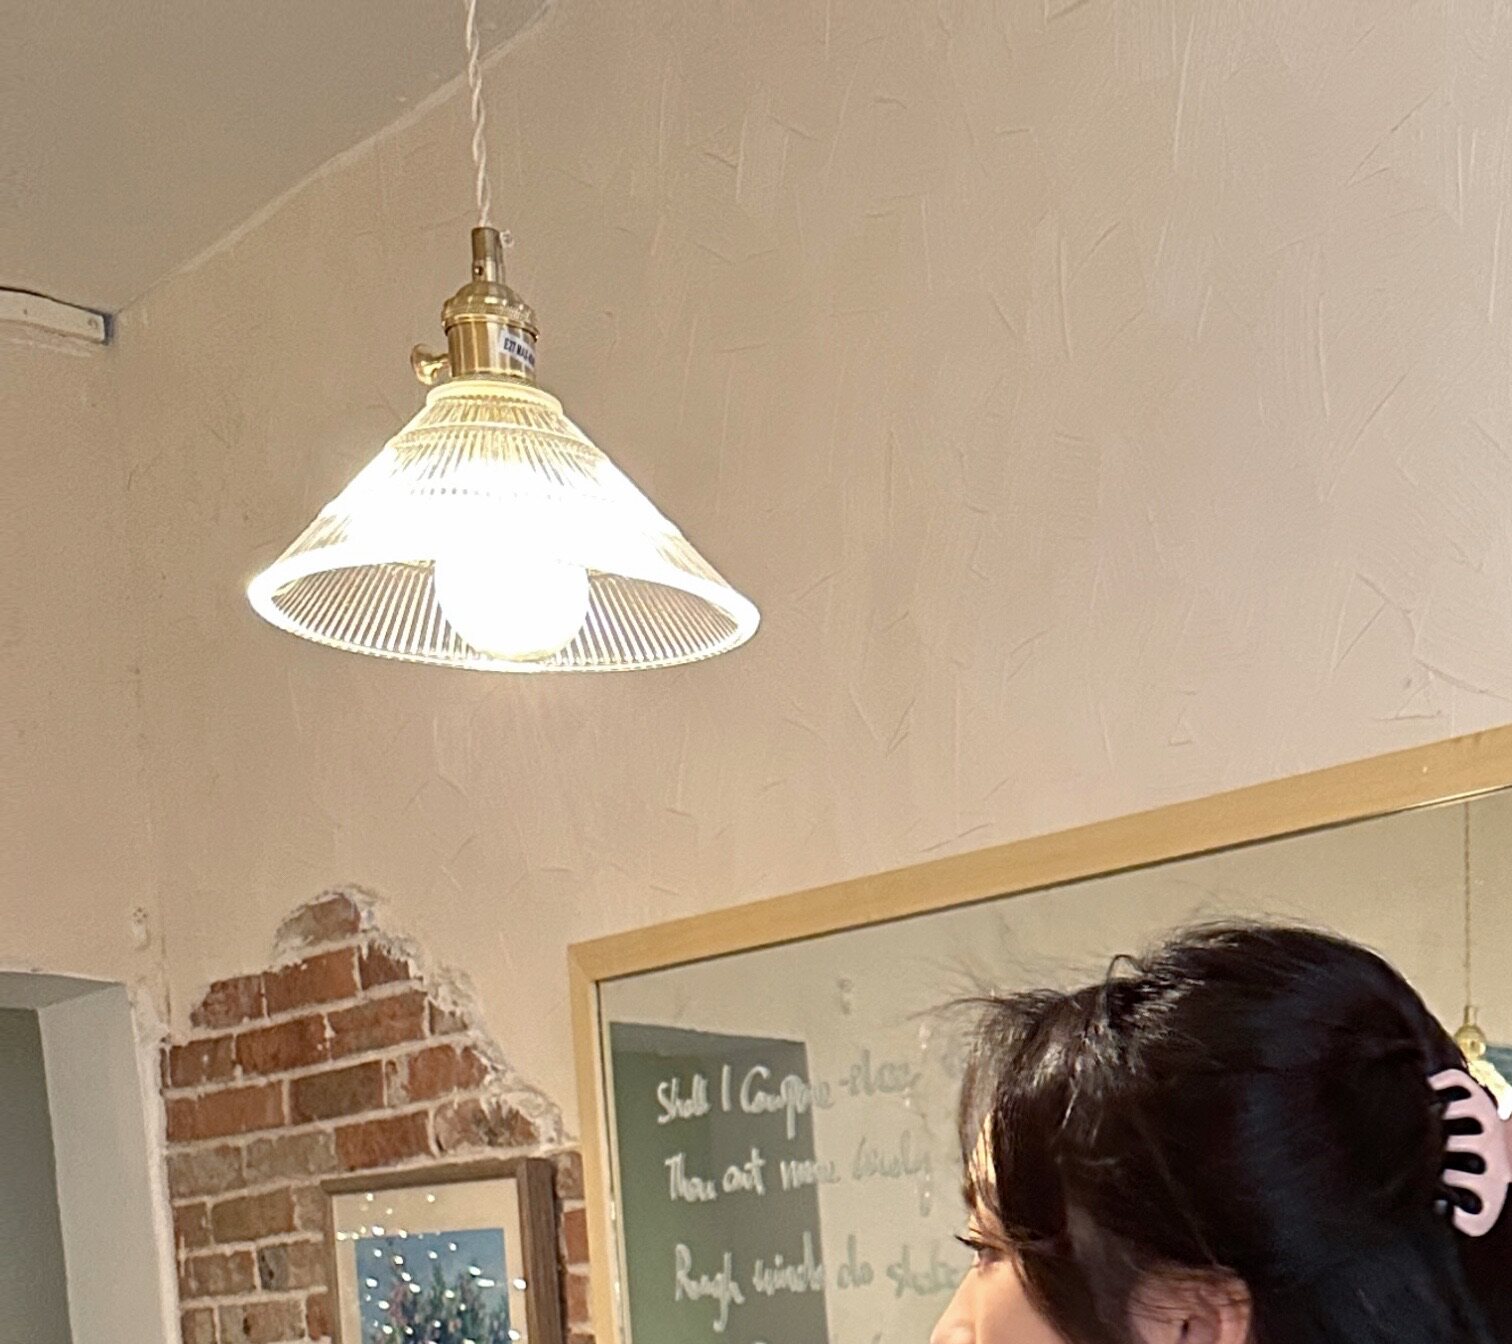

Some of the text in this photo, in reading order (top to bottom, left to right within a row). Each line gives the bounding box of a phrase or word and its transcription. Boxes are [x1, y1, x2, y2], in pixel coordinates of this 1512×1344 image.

[657, 1073, 711, 1124] Shall
[722, 1064, 732, 1112] I
[664, 1152, 717, 1201] Thou
[722, 1147, 766, 1196] art
[675, 1242, 745, 1332] Rough
[753, 1230, 825, 1296] winds
[837, 1233, 875, 1290] do
